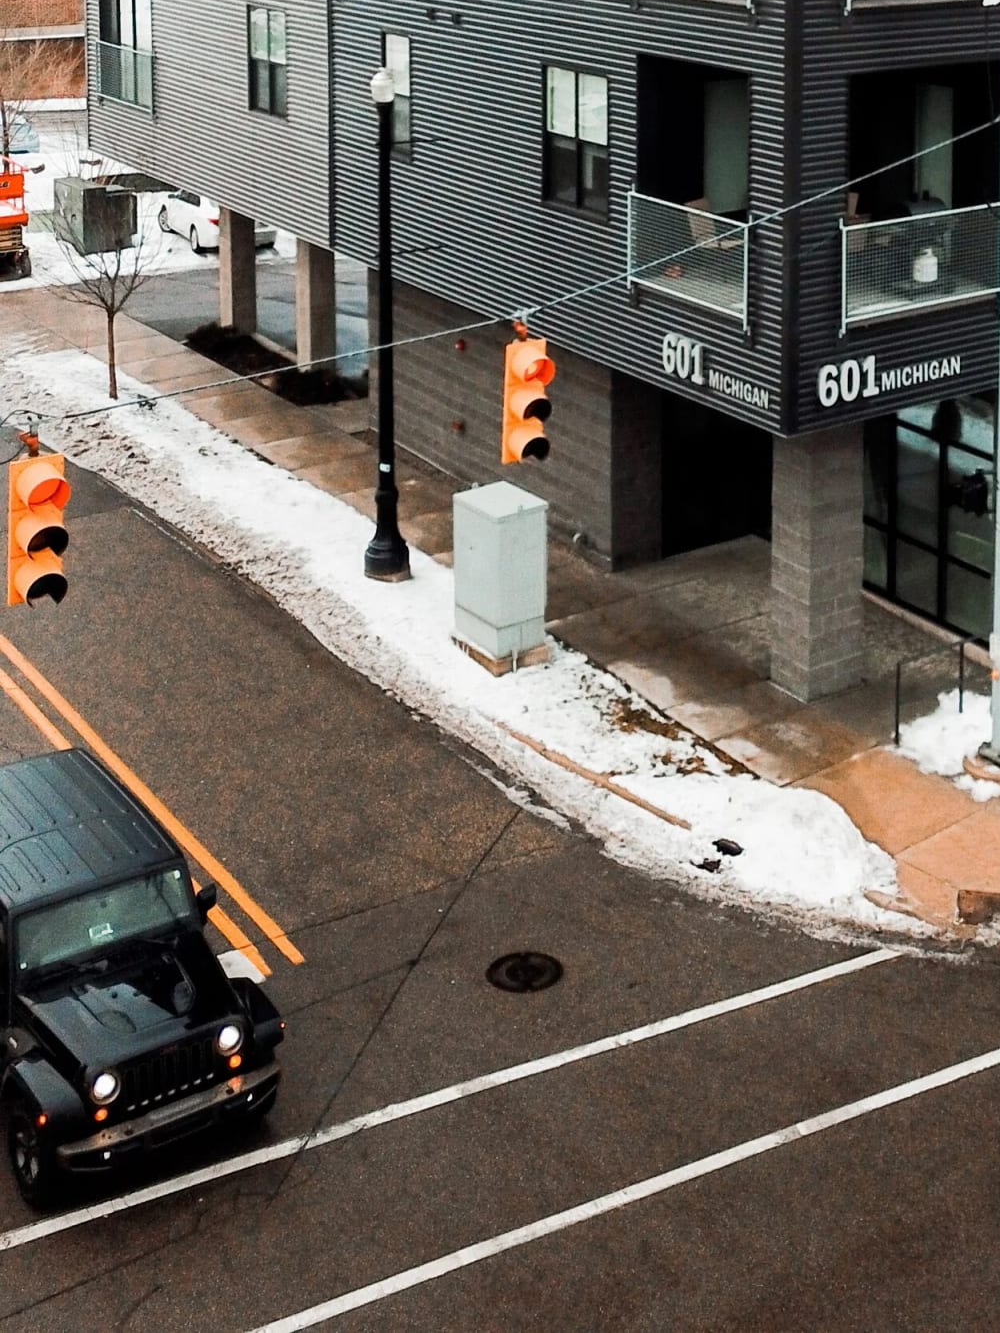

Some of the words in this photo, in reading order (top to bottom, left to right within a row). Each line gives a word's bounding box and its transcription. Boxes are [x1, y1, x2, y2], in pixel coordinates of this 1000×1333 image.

[661, 332, 703, 385] 601
[708, 368, 769, 409] MICHIGAN
[817, 355, 880, 407] 601
[881, 356, 961, 392] MICHIGAN
